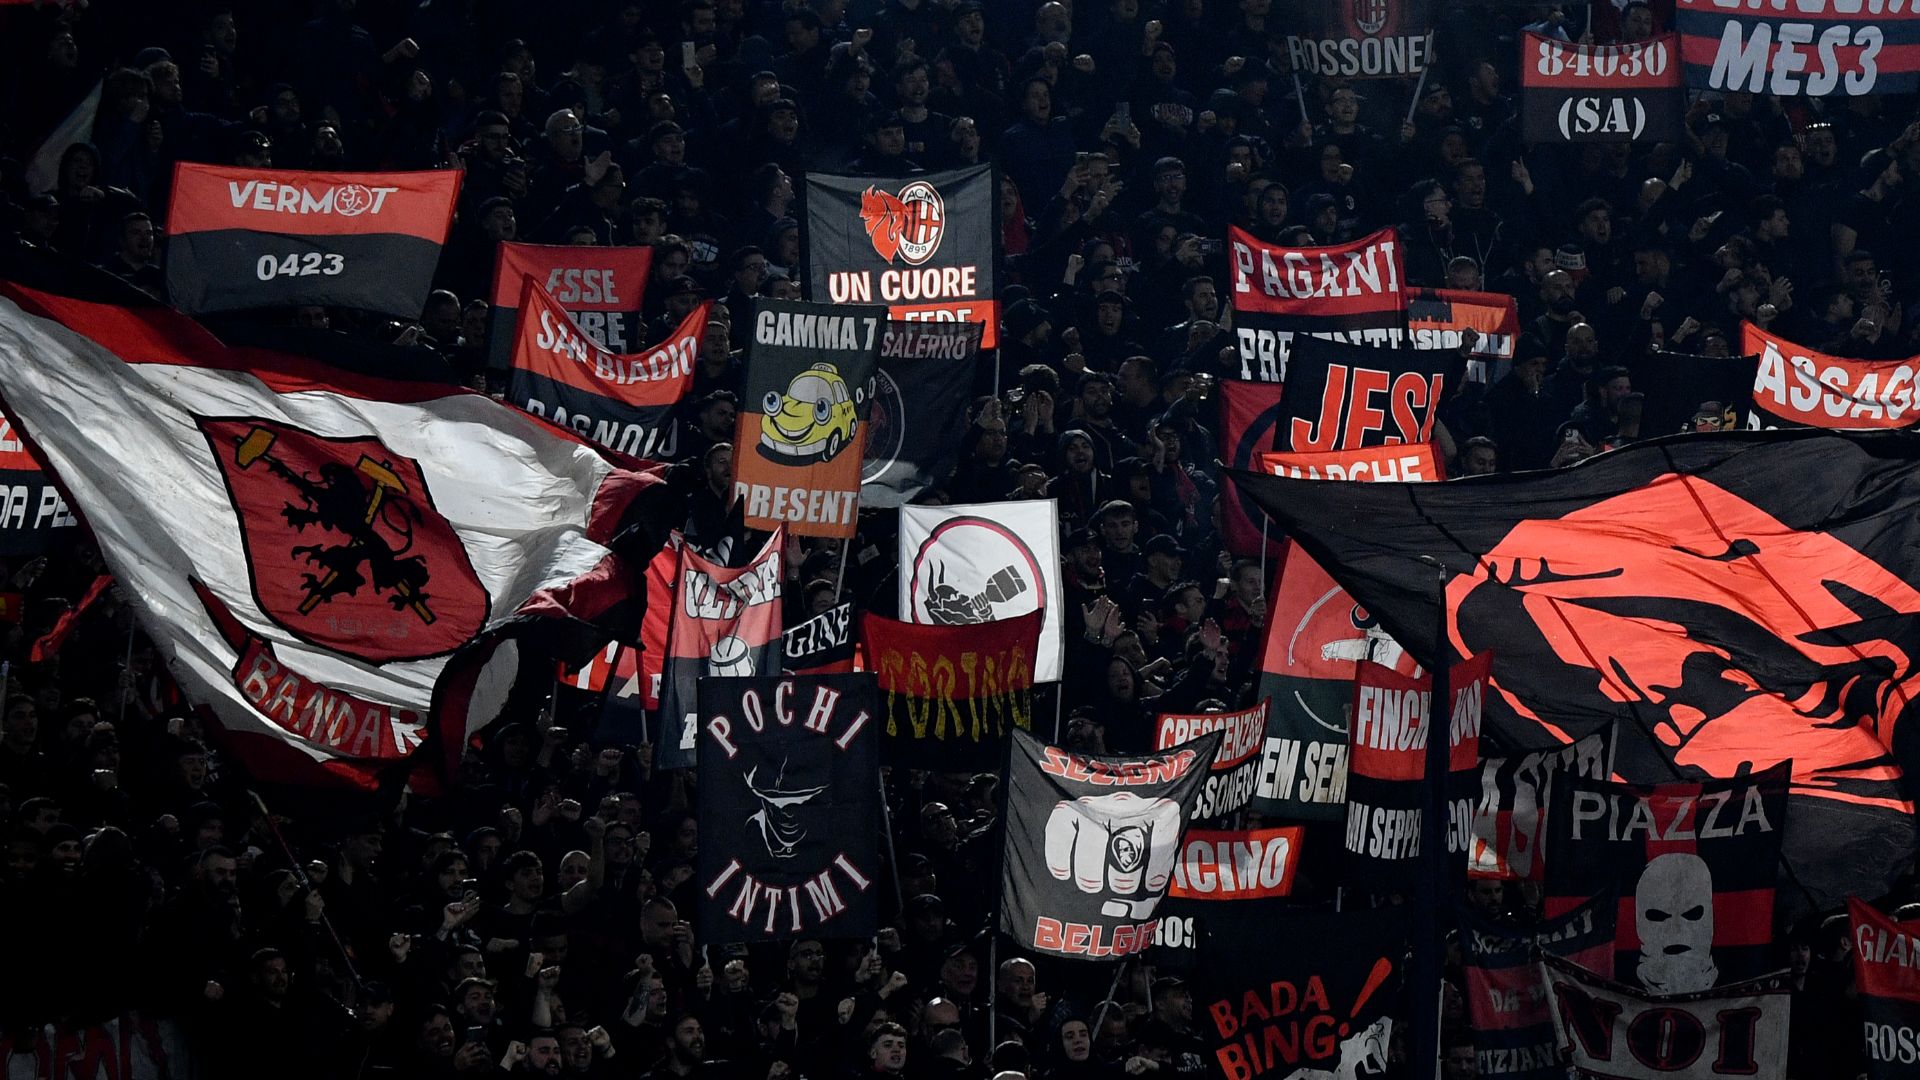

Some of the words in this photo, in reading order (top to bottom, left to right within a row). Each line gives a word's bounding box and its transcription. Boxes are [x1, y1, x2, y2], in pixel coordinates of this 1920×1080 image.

[1537, 41, 1668, 77] 84030
[1708, 20, 1885, 96] MES3
[1557, 96, 1647, 140] (SA)
[229, 180, 400, 217] VERMOT
[906, 189, 934, 203] ACM
[256, 252, 345, 281] 0423
[904, 243, 928, 254] 1899
[1233, 240, 1399, 299] PAGANI
[828, 271, 872, 303] UN
[880, 266, 977, 301] CUORE
[536, 309, 589, 364] SAN
[594, 335, 698, 385] BIAGIO
[756, 310, 859, 351] GAMMA
[863, 317, 878, 351] 7
[880, 330, 968, 361] SALERNO
[1753, 340, 1920, 420] ASSAG
[1290, 363, 1445, 452] JESI
[33, 486, 78, 529] PE
[706, 681, 870, 758] POCHI
[1255, 737, 1302, 800] EM
[1571, 785, 1775, 842] PIAZZA
[706, 854, 871, 933] INTIMI
[1208, 974, 1332, 1041] BADA
[1552, 981, 1764, 1076] NOI
[1477, 1041, 1556, 1076] TIZIAN
